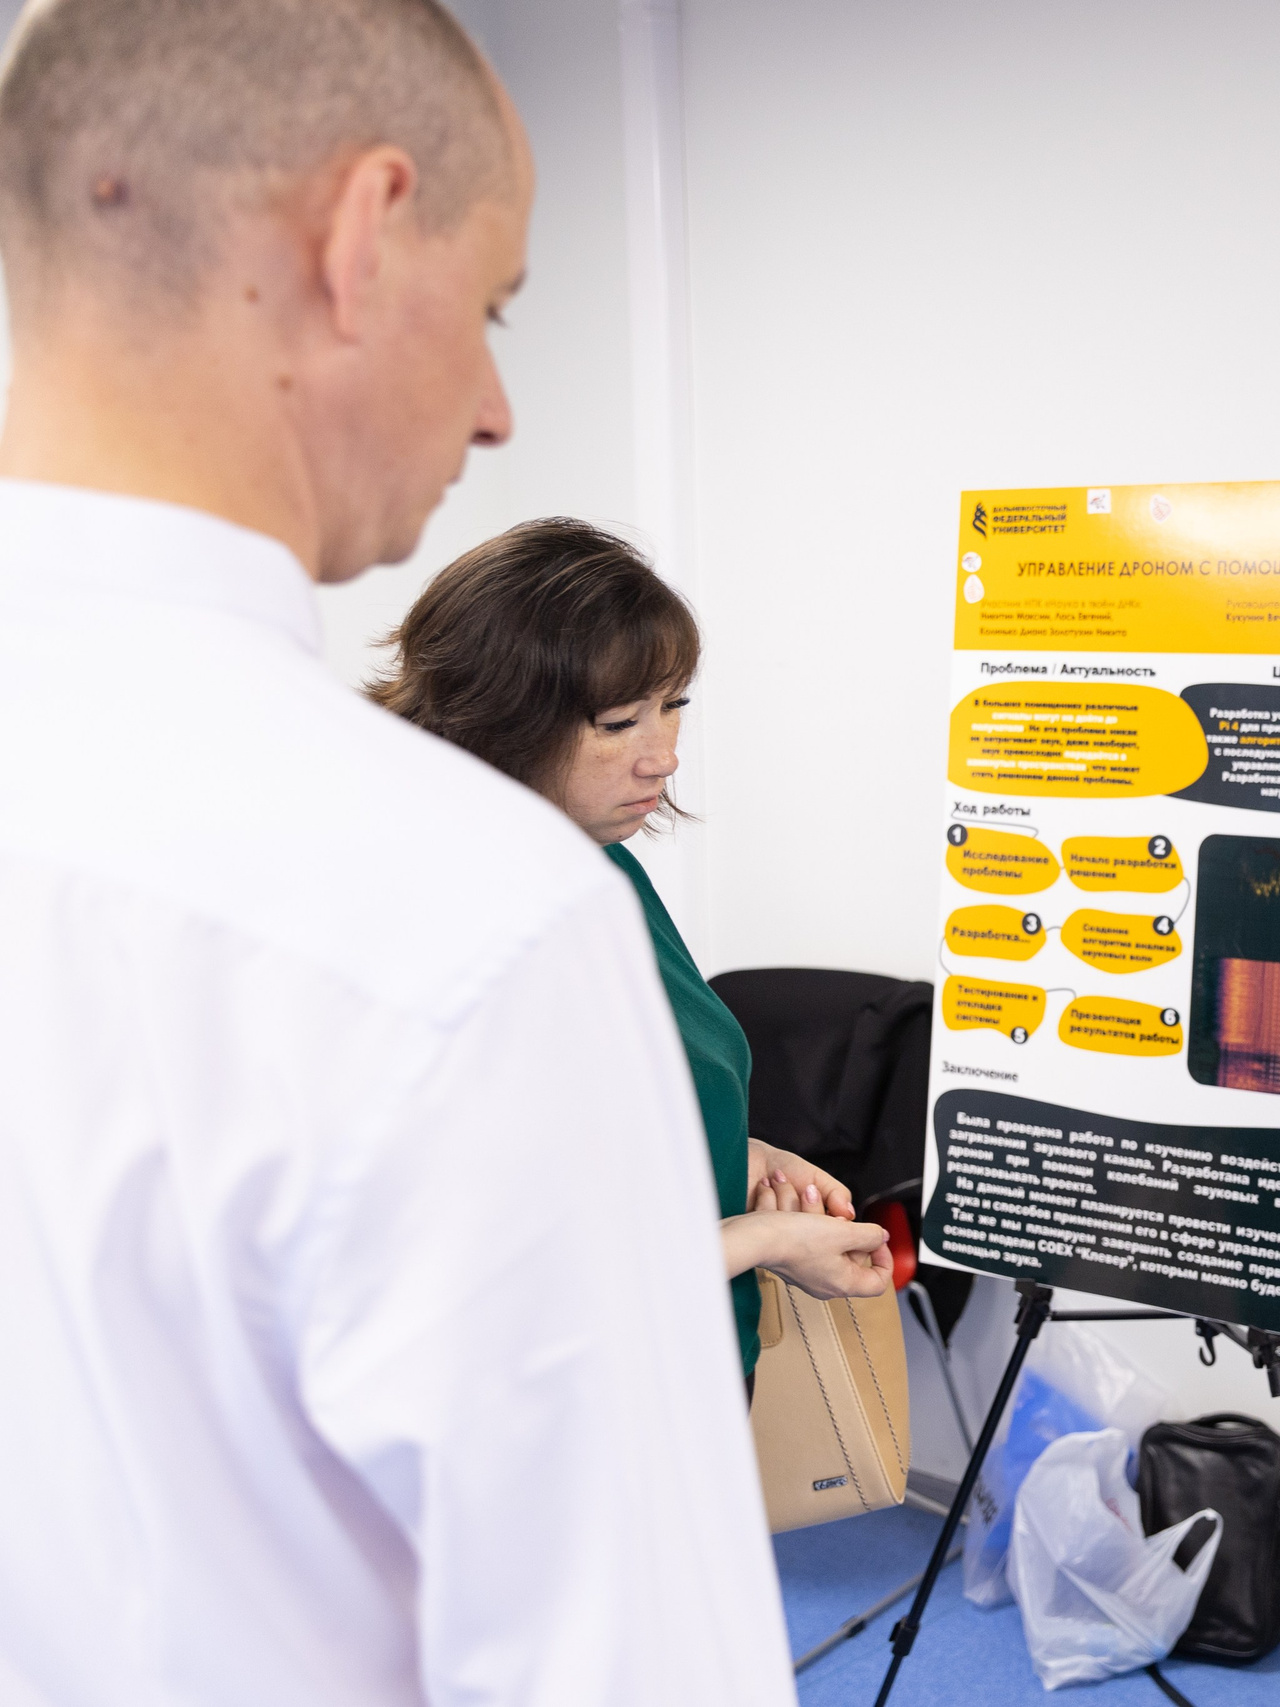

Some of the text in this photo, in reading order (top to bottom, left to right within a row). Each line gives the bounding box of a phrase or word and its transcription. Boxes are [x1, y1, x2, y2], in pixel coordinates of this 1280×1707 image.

[993, 513, 1067, 522] ФЕДЕРАЛЬНЫЙ
[992, 525, 1066, 534] УНИВЕРСИТЕТ
[1017, 560, 1114, 577] УПРАВЛЕНИЕ
[1119, 560, 1194, 577] ДРОНОМ
[1199, 560, 1211, 575] С
[981, 662, 1156, 679] Проблема Актуальность
[1210, 708, 1270, 722] Разработка
[1219, 720, 1229, 731] Pi
[1240, 723, 1260, 733] для
[1206, 735, 1238, 745] также
[953, 801, 1031, 816] Ход работы
[952, 826, 962, 844] 1
[1153, 840, 1166, 855] 2
[962, 850, 1049, 865] Исследование
[1070, 854, 1177, 870] Начало разработки
[962, 865, 1023, 879] проблемы
[1027, 916, 1038, 932] 3
[1157, 917, 1169, 933] 4
[1071, 1009, 1141, 1025] Презентация
[1164, 1010, 1176, 1025] 6
[1014, 1028, 1026, 1042] 5
[1069, 1024, 1179, 1045] результатов работы
[942, 1061, 1018, 1082] Заключение
[956, 1111, 991, 1129] Была
[996, 1119, 1063, 1139] проведена
[1069, 1130, 1114, 1147] работа
[1121, 1138, 1138, 1151] по
[1145, 1142, 1214, 1162] изучению
[949, 1128, 1027, 1150] загрязнения
[1033, 1141, 1097, 1161] звукового
[1103, 1153, 1155, 1170] канала.
[1162, 1160, 1250, 1185] Разработана
[947, 1145, 994, 1162] дроном
[1006, 1154, 1030, 1168] при
[1042, 1159, 1094, 1178] помощи
[1107, 1169, 1179, 1191] колебаний
[1193, 1184, 1259, 1204] звуковых
[947, 1161, 1097, 1195] реализовывать проекта.
[956, 1176, 974, 1190] На
[976, 1181, 1026, 1200] данный
[1029, 1189, 1077, 1208] момент
[1080, 1198, 1164, 1223] планируется
[1169, 1214, 1231, 1235] провести
[945, 1191, 980, 1208] звука
[982, 1199, 991, 1210] и
[992, 1199, 1050, 1220] способов
[1053, 1210, 1133, 1235] применения
[1134, 1225, 1158, 1239] его
[1159, 1229, 1169, 1240] в
[1171, 1231, 1215, 1249] сфере
[951, 1207, 974, 1223] Так
[977, 1214, 997, 1227] же
[1000, 1218, 1022, 1231] мы
[1025, 1222, 1097, 1244] планируем
[1101, 1235, 1173, 1259] завершить
[1177, 1249, 1243, 1271] создание
[942, 1240, 1042, 1269] помощью звука.
[943, 1224, 987, 1242] основе
[988, 1232, 1036, 1251] модели
[1139, 1258, 1199, 1282] которым
[1201, 1271, 1248, 1290] можно
